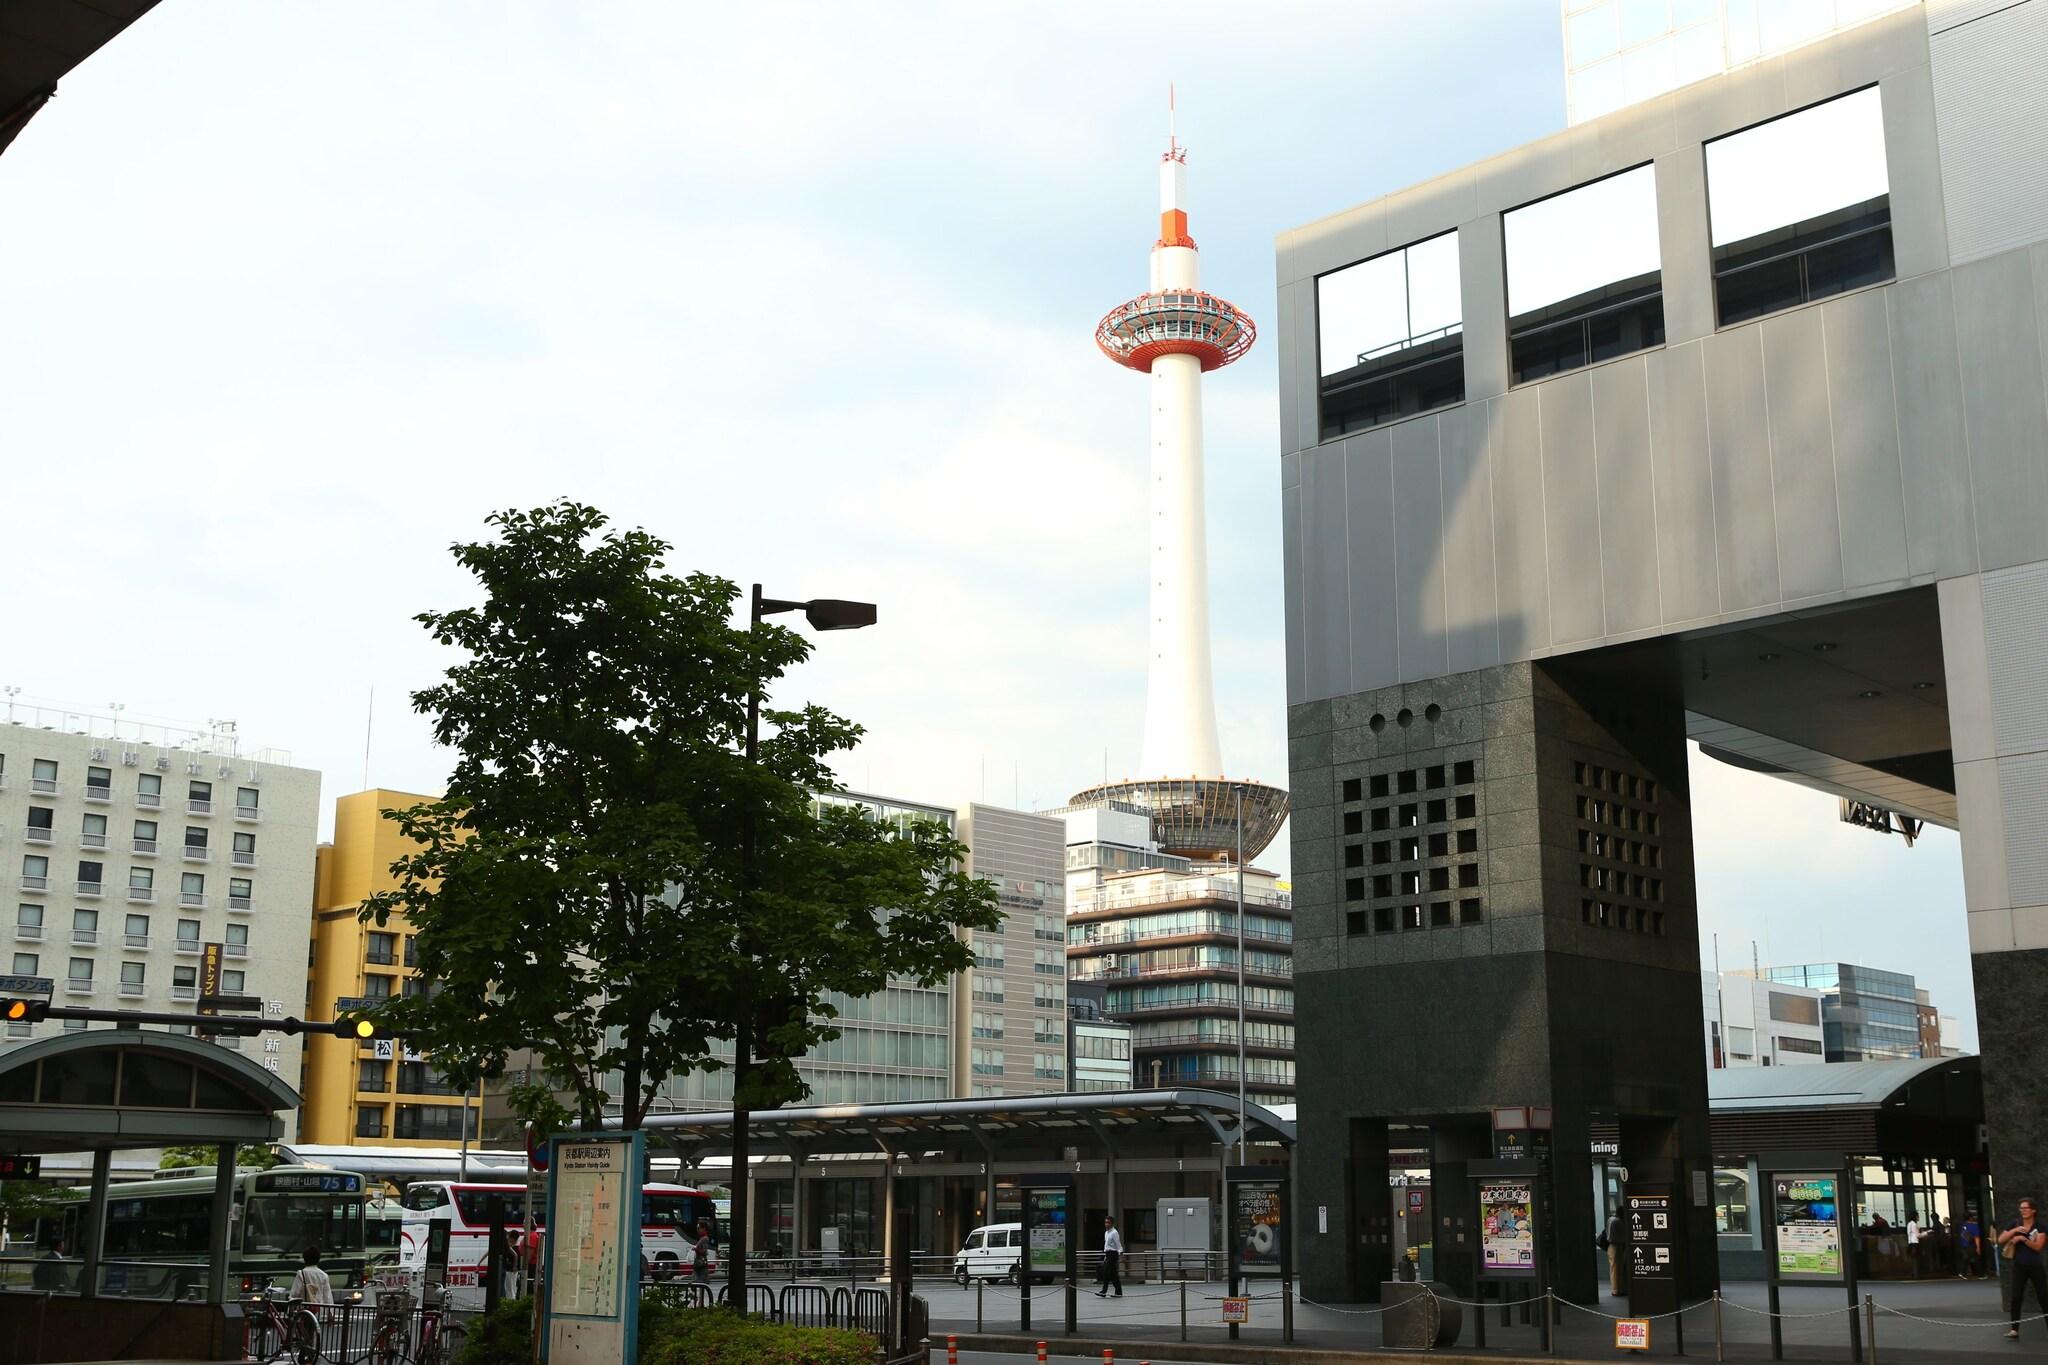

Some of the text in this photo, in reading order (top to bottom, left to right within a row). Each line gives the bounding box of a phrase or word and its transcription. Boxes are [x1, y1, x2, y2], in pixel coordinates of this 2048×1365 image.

[264, 1000, 283, 1072] 京新阪
[565, 1146, 611, 1159] 京都駅周辺案内
[600, 1161, 610, 1169] Guide
[980, 1163, 986, 1174] 3
[1075, 1161, 1081, 1172] 2
[821, 1167, 826, 1177] 5
[323, 1177, 341, 1190] 75
[1616, 1324, 1645, 1337] 横断禁止
